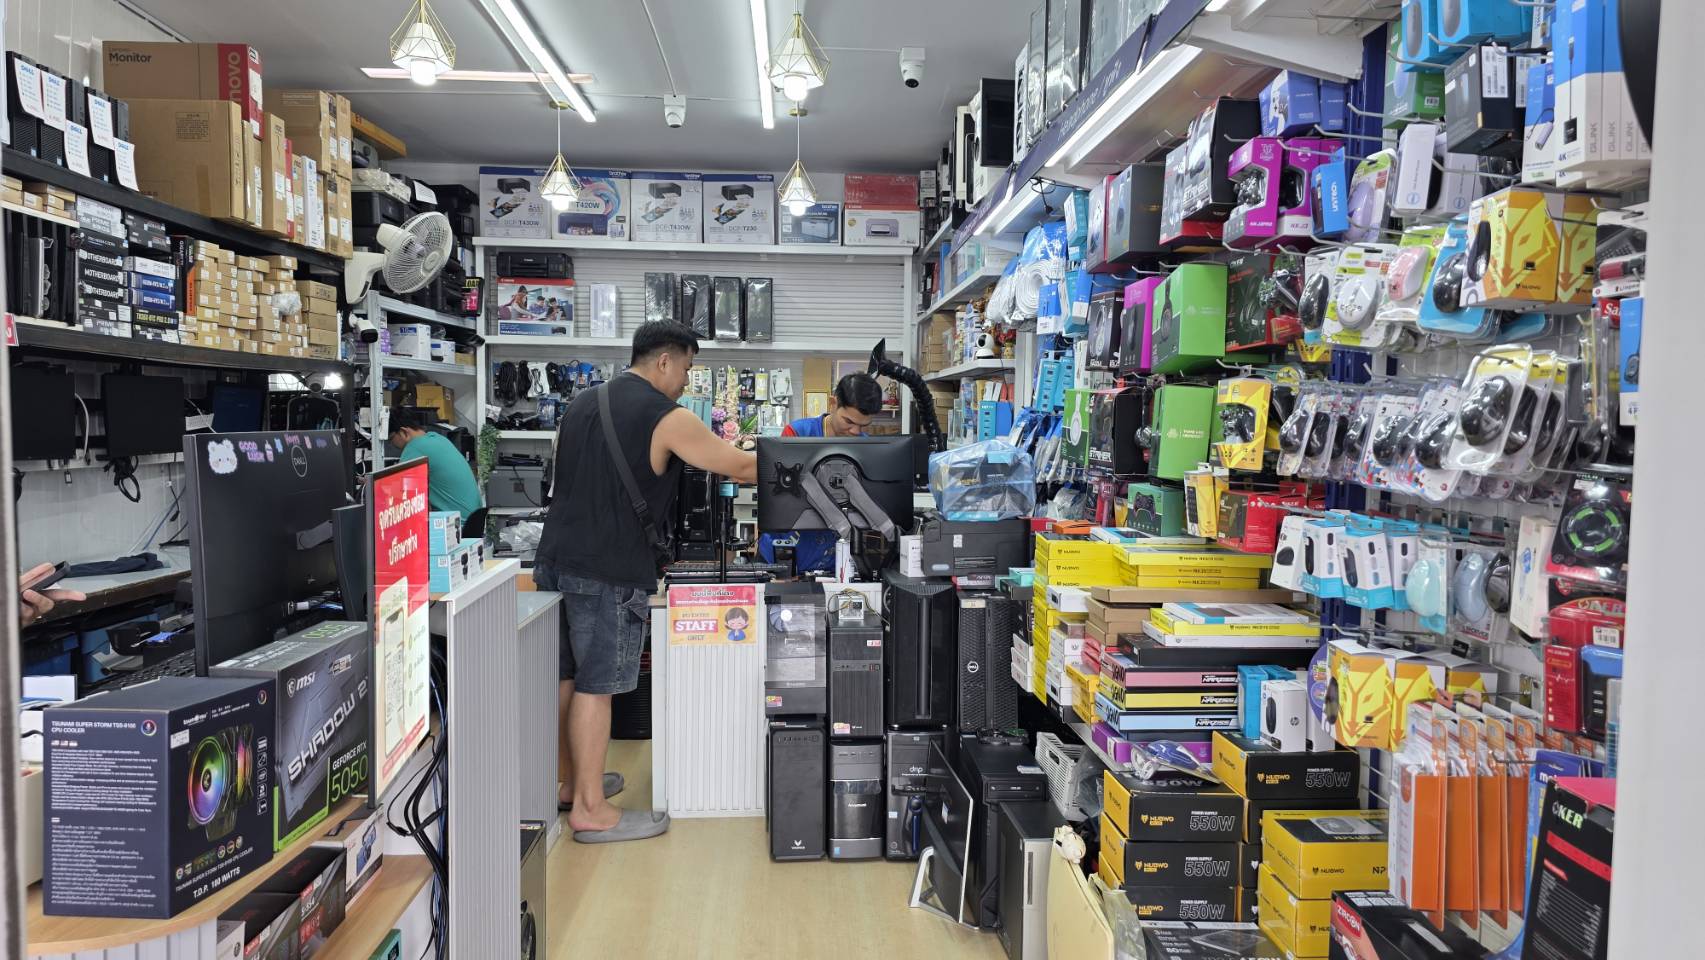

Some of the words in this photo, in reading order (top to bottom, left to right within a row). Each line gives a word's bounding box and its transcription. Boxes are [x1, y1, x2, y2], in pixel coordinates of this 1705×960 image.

[108, 53, 152, 64] Monitor
[227, 52, 241, 100] novo
[575, 201, 600, 209] T420W
[675, 620, 716, 632] STAFF
[296, 671, 316, 691] msi
[288, 693, 356, 782] SHADOW
[332, 747, 356, 770] GEFORCE
[356, 740, 368, 755] RTX
[331, 754, 369, 802] 5050
[1305, 772, 1350, 788] 550W
[1190, 816, 1235, 831] 550W
[221, 867, 240, 883] WATTS
[1184, 861, 1230, 876] 550W
[1179, 904, 1225, 919] 550W
[1337, 905, 1360, 931] ZIRCON
